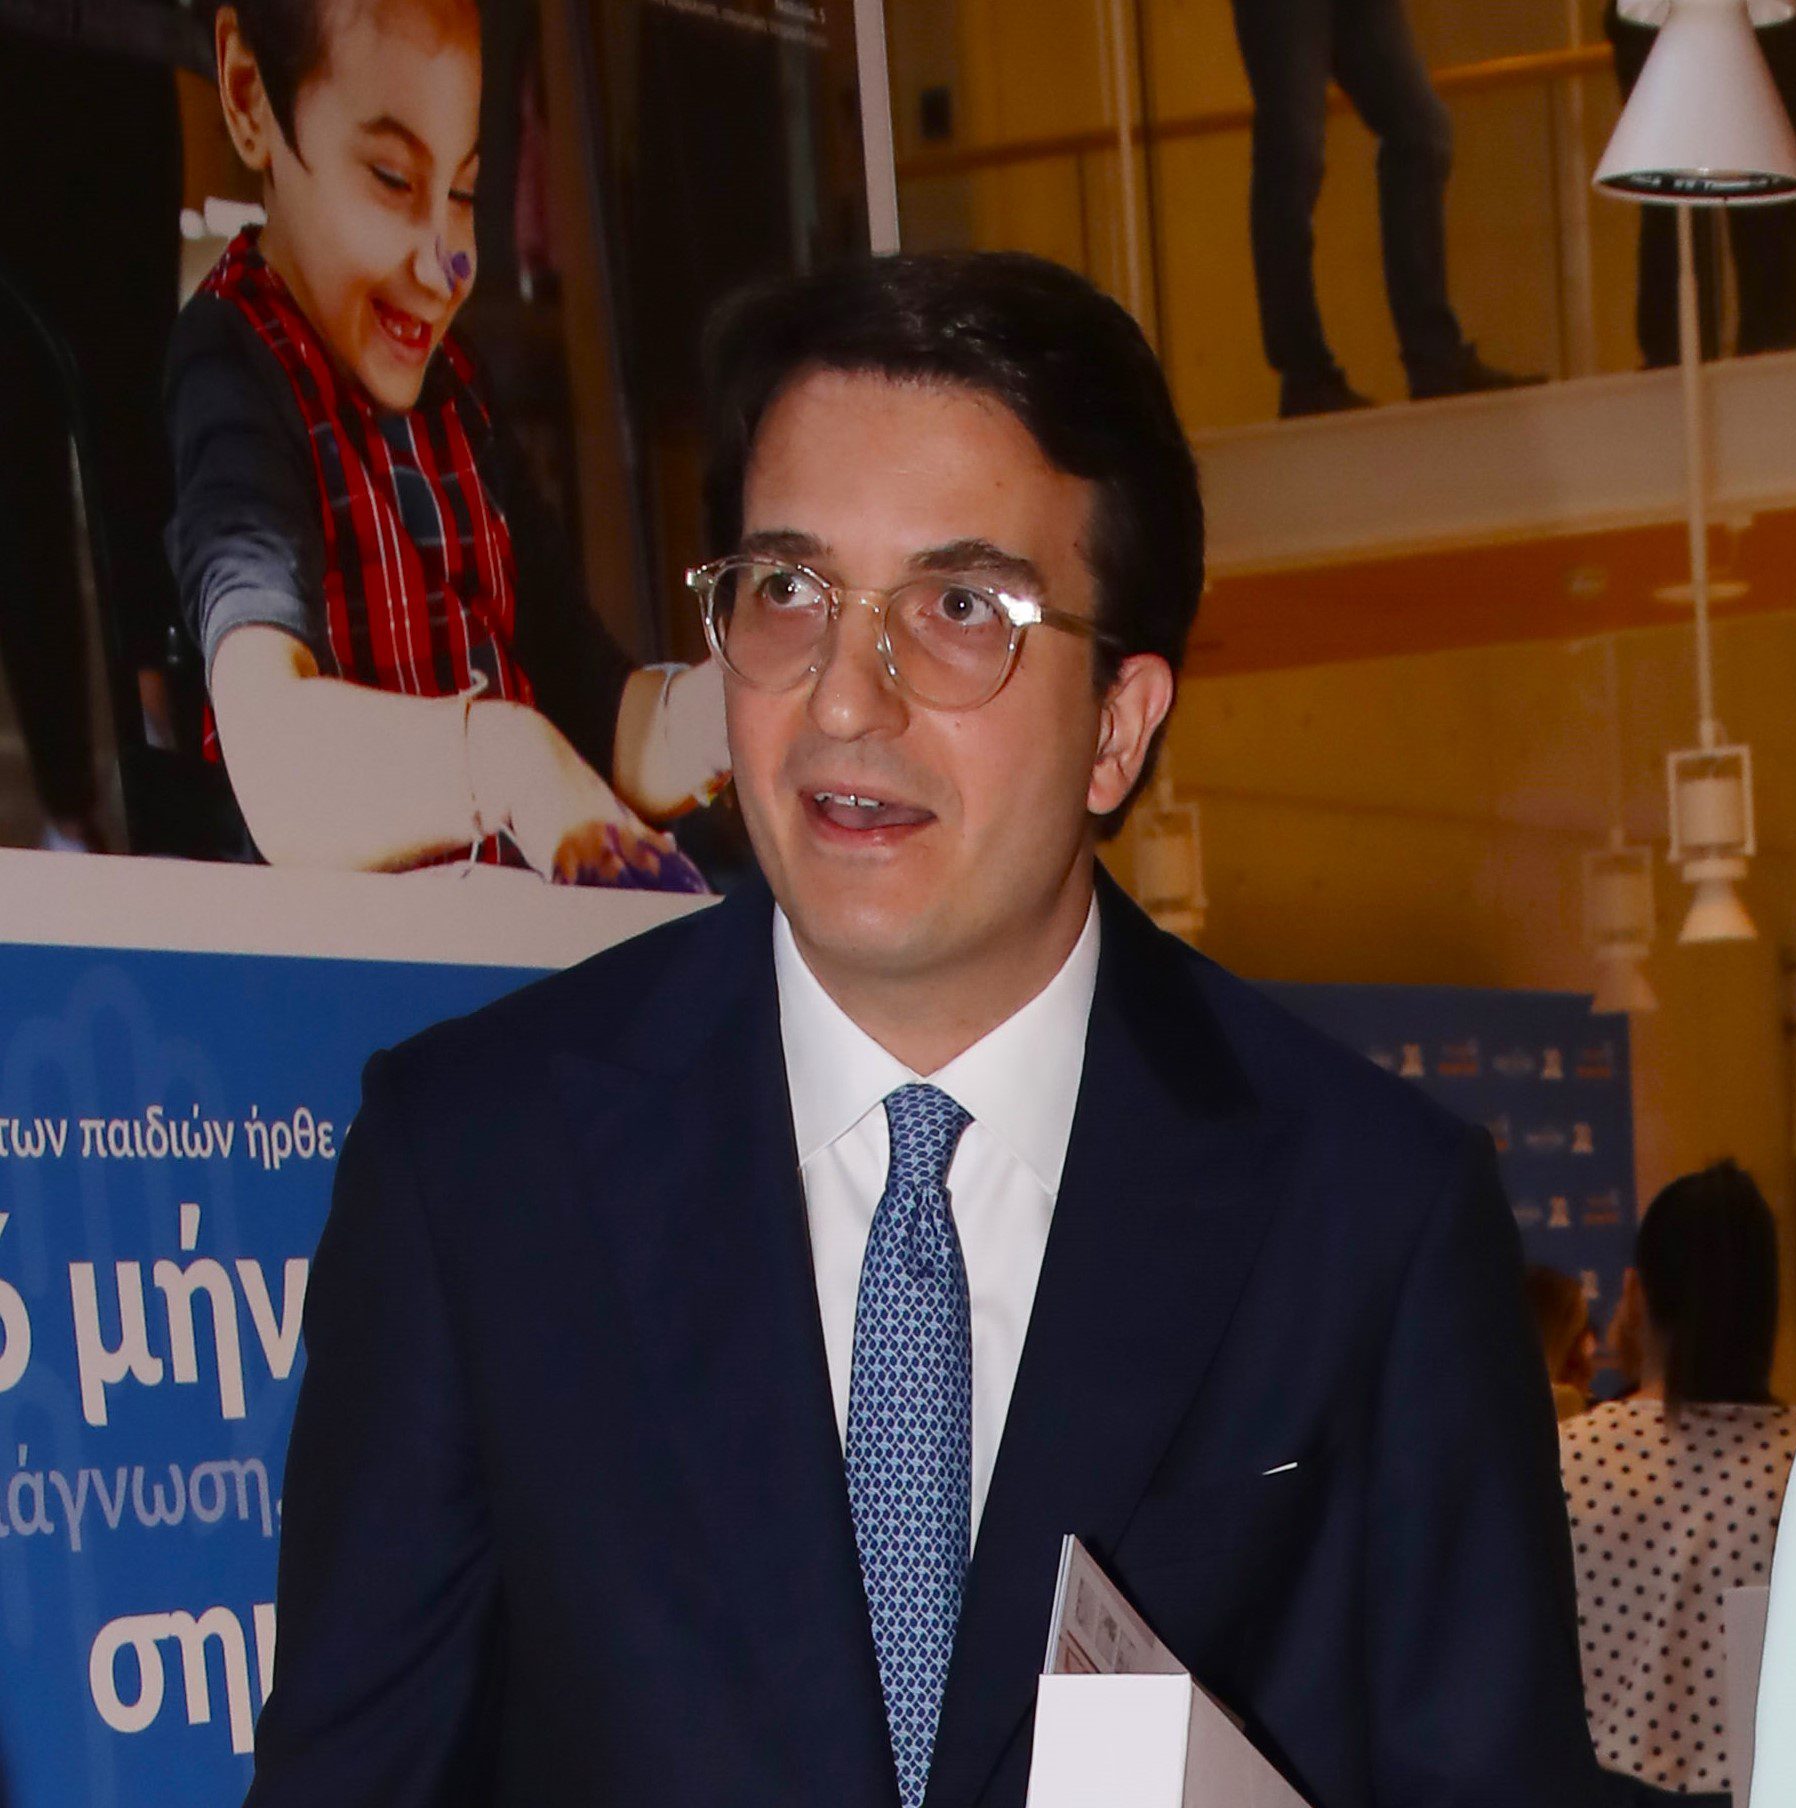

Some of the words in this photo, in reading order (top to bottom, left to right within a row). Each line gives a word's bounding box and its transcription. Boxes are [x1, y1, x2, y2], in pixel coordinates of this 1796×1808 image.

[79, 1103, 235, 1159] παιδιών
[244, 1104, 337, 1171] ήρθε
[68, 1202, 310, 1428] μήν
[0, 1443, 282, 1553] άγνωση
